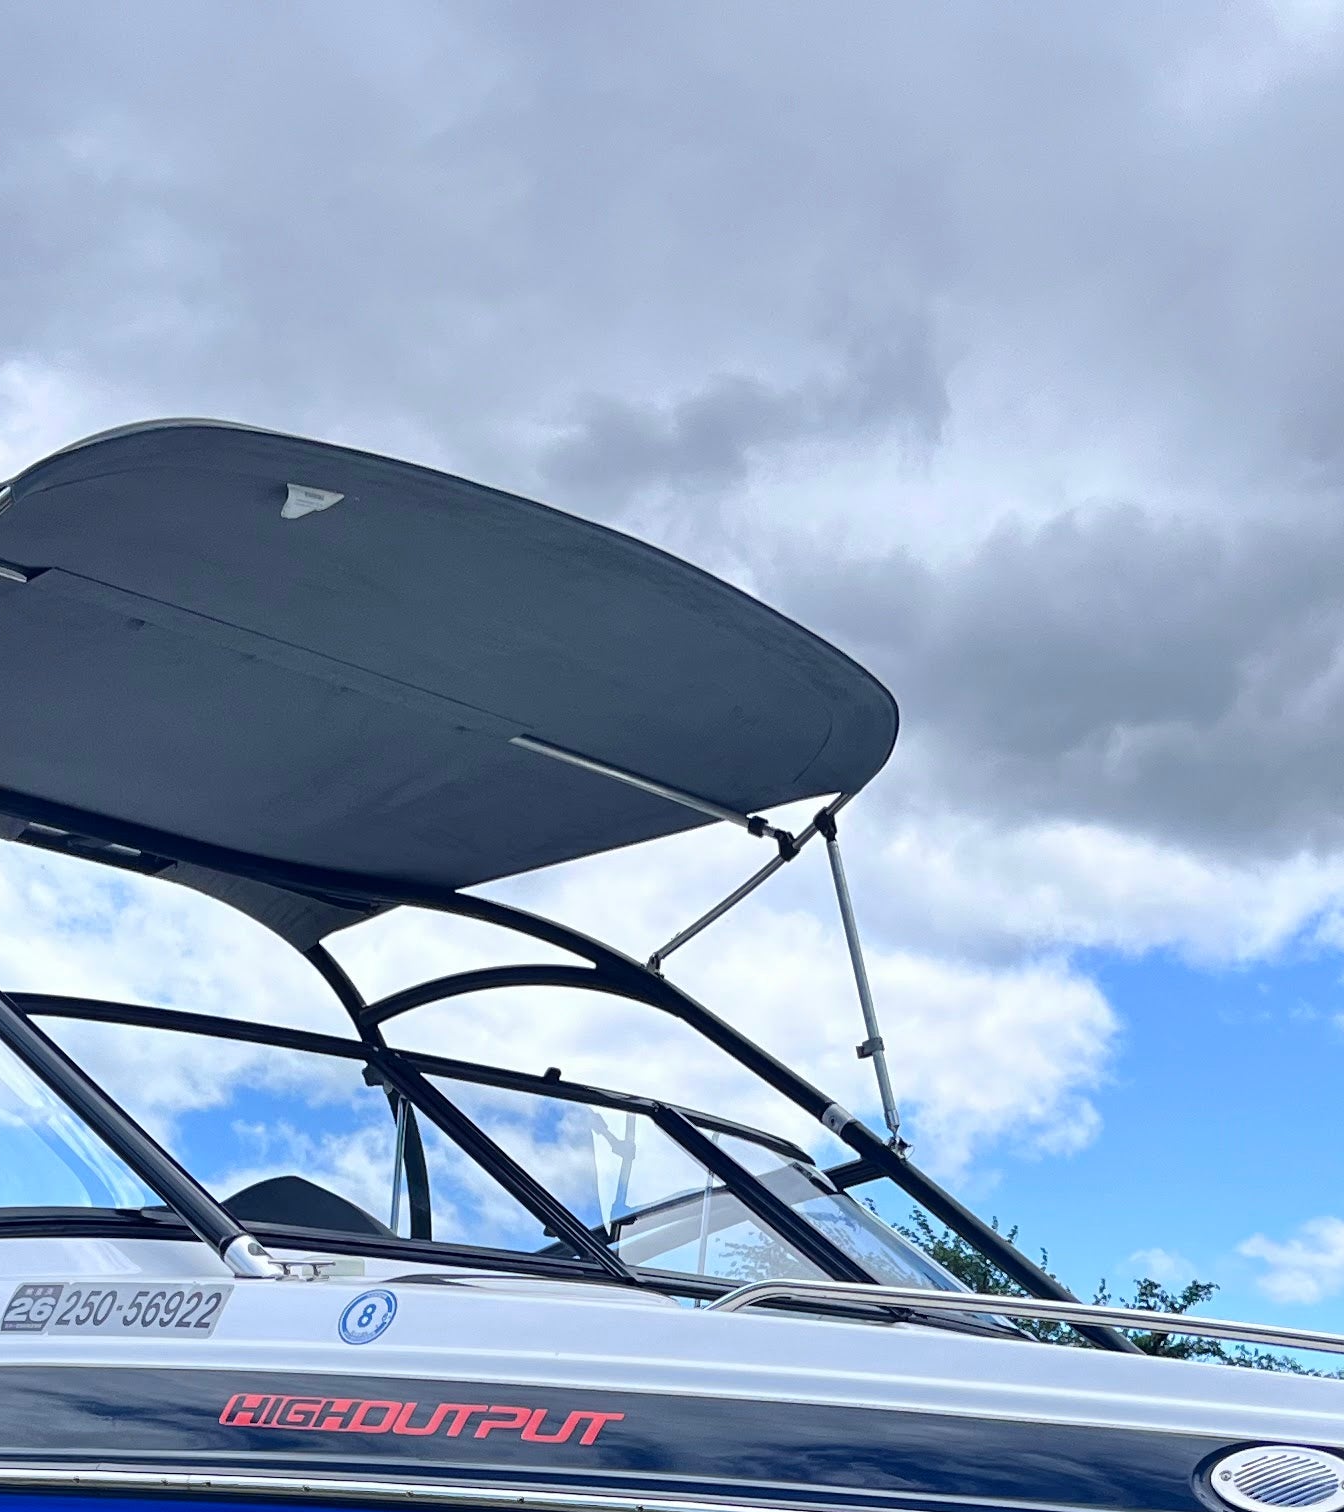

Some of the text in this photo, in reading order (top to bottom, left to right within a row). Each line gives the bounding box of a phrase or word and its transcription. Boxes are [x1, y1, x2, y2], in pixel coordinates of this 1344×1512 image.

[4, 1297, 56, 1322] 26
[55, 1290, 223, 1329] 250-56922
[357, 1303, 377, 1328] 8
